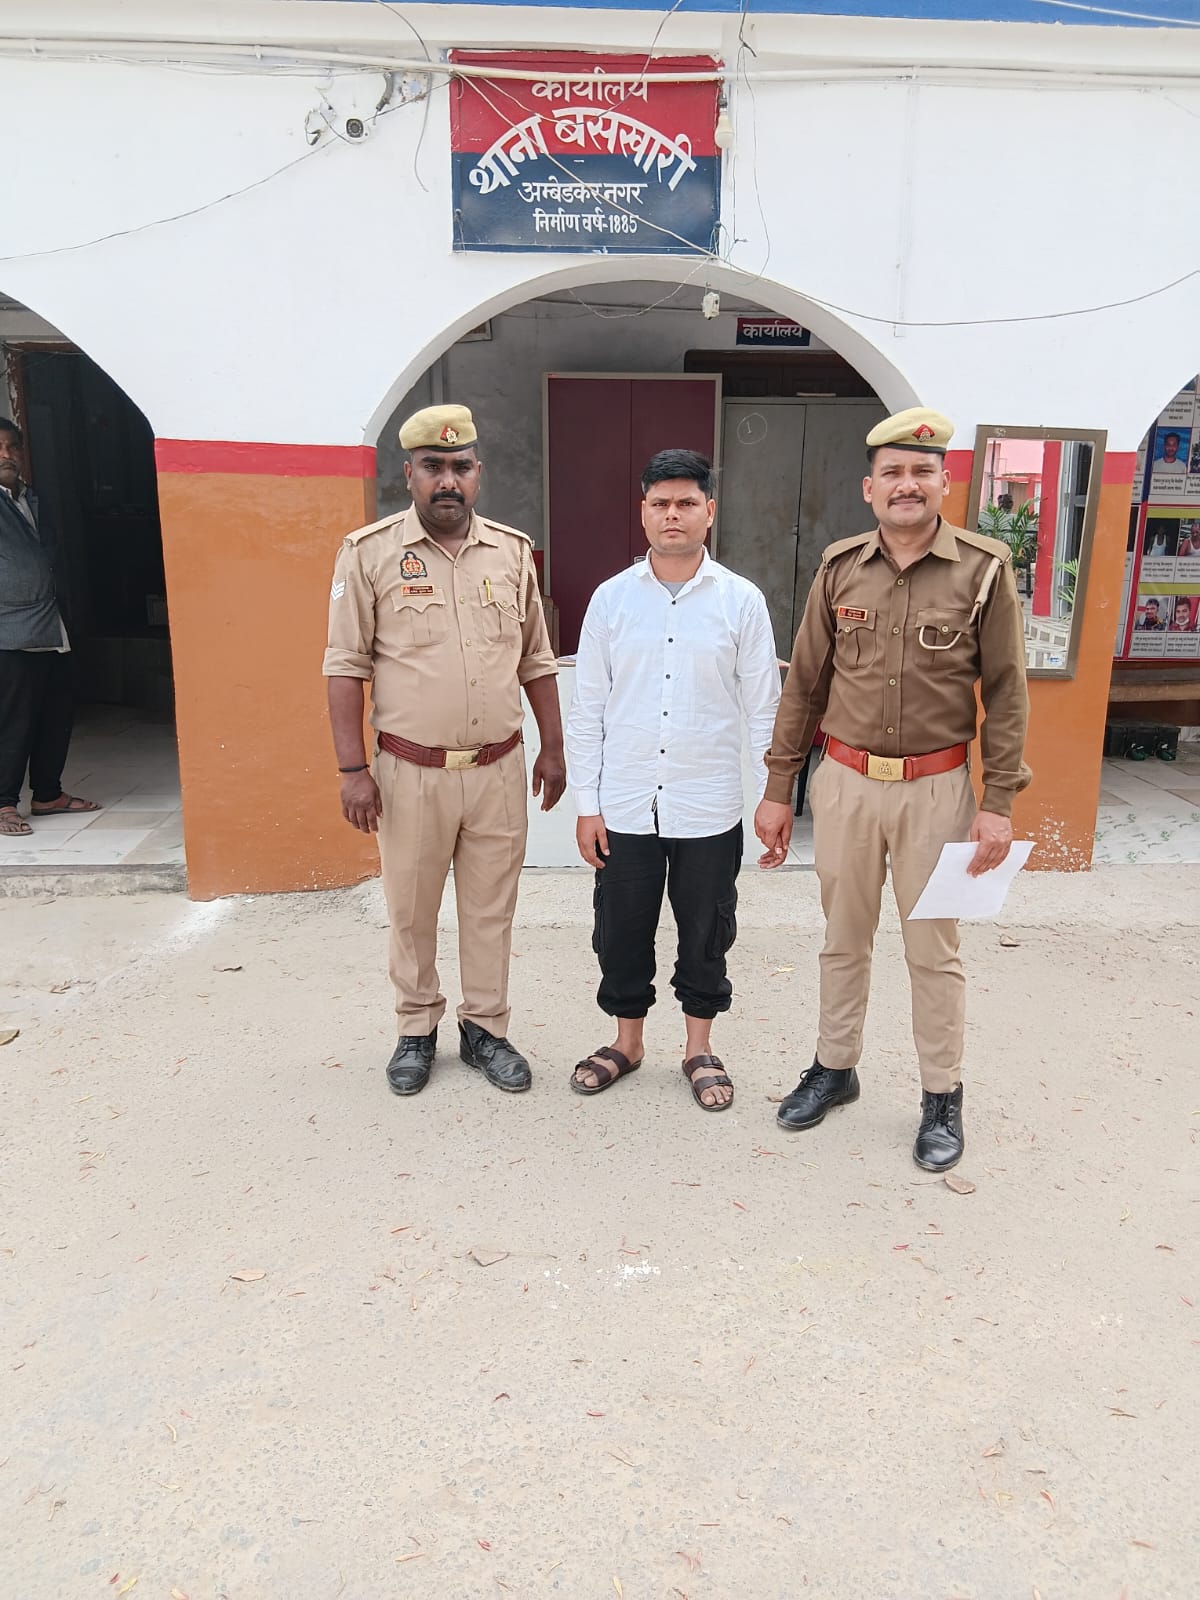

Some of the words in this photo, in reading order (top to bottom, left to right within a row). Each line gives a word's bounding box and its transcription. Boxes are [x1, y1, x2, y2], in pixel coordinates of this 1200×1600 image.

[469, 115, 549, 194] थाना
[552, 107, 697, 191] बसखारी
[533, 207, 580, 233] निर्माण
[742, 320, 803, 338] कार्यालय
